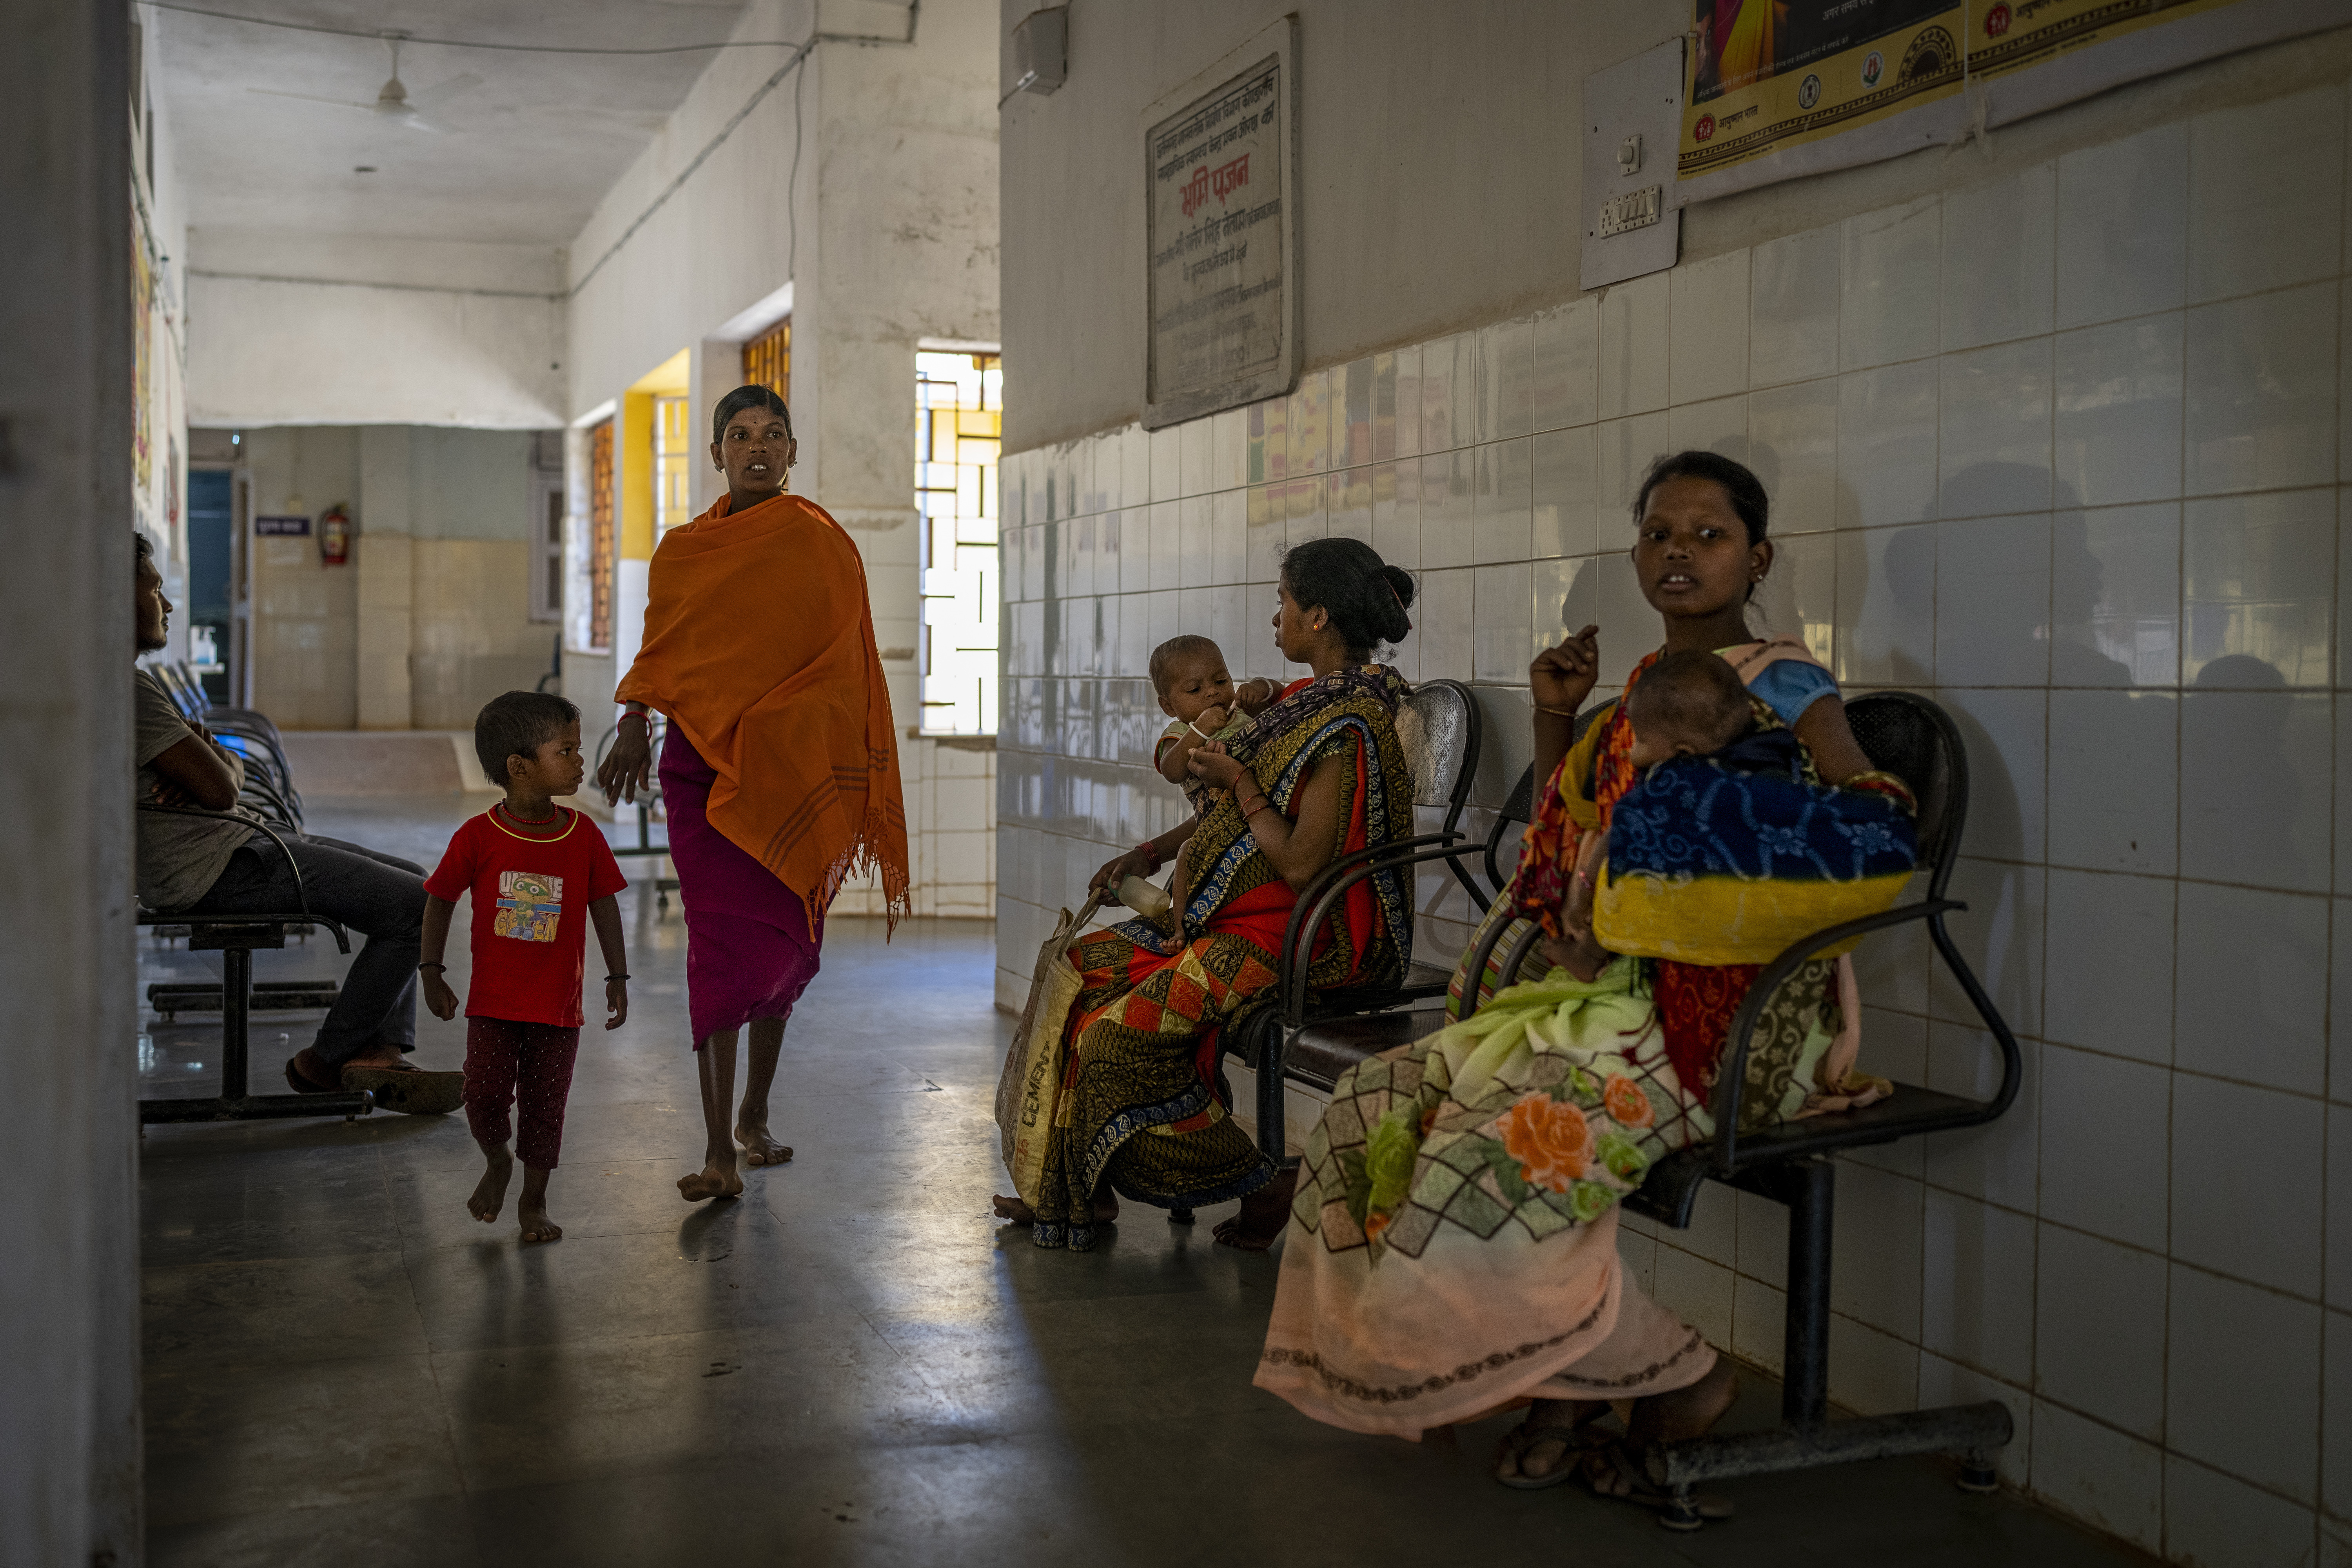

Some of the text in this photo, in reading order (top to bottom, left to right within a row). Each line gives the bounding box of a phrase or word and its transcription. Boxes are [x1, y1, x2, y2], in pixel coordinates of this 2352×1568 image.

[1822, 6, 1839, 20] अगर
[1719, 105, 1758, 129] आयुष्मान भारत
[1180, 165, 1209, 220] भूमि
[1210, 152, 1250, 207] पूजन
[1222, 207, 1245, 238] नेताम
[1022, 1040, 1049, 1128] CEMENT
